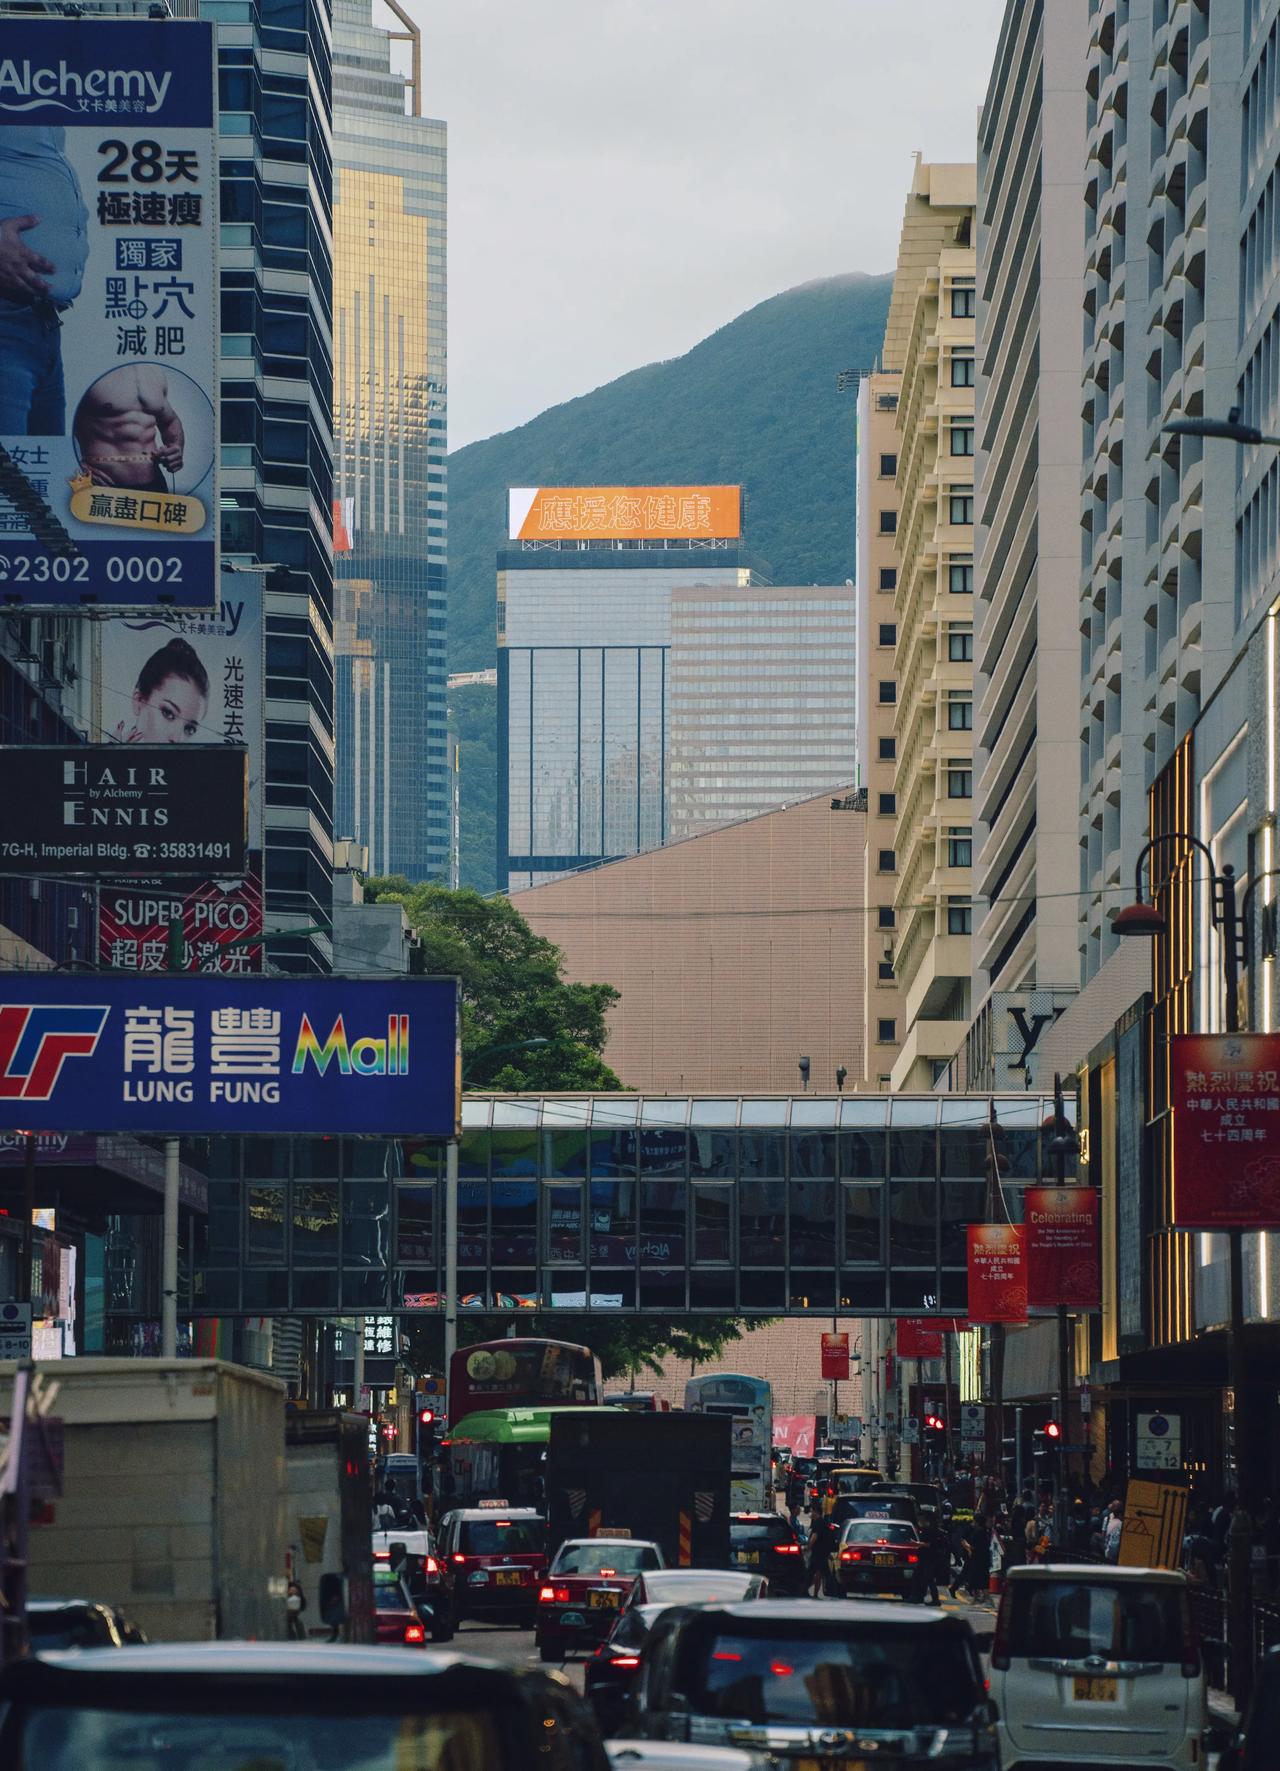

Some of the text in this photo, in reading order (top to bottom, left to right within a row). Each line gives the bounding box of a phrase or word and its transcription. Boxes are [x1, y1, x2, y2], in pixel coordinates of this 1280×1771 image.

[0, 59, 172, 113] Alchemy
[77, 99, 145, 113] 艾卡美美容
[97, 140, 198, 183] 28天
[97, 191, 202, 226] 極速瘦
[120, 241, 178, 268] 獨家
[116, 325, 186, 356] 減肥
[89, 494, 187, 526] 贏盡口碑
[538, 495, 711, 531] 應援您健康
[14, 556, 183, 582] 2302 0002
[223, 656, 244, 744] 光速去
[63, 760, 168, 785] HAIR
[89, 787, 144, 799] by Alchemy
[63, 801, 169, 826] ENNIS
[41, 843, 93, 859] Imperial
[97, 843, 130, 860] Bldg.
[114, 899, 250, 930] SUPER PICO
[292, 1012, 410, 1077] Mall
[123, 1080, 281, 1103] LUNG FUNG
[1186, 1070, 1280, 1093] 熱烈慶祝
[1186, 1097, 1280, 1111] 中華人民共和國
[1220, 1114, 1246, 1126] 成立
[1201, 1129, 1267, 1143] 七十四周年
[1030, 1211, 1093, 1225] Celebrating
